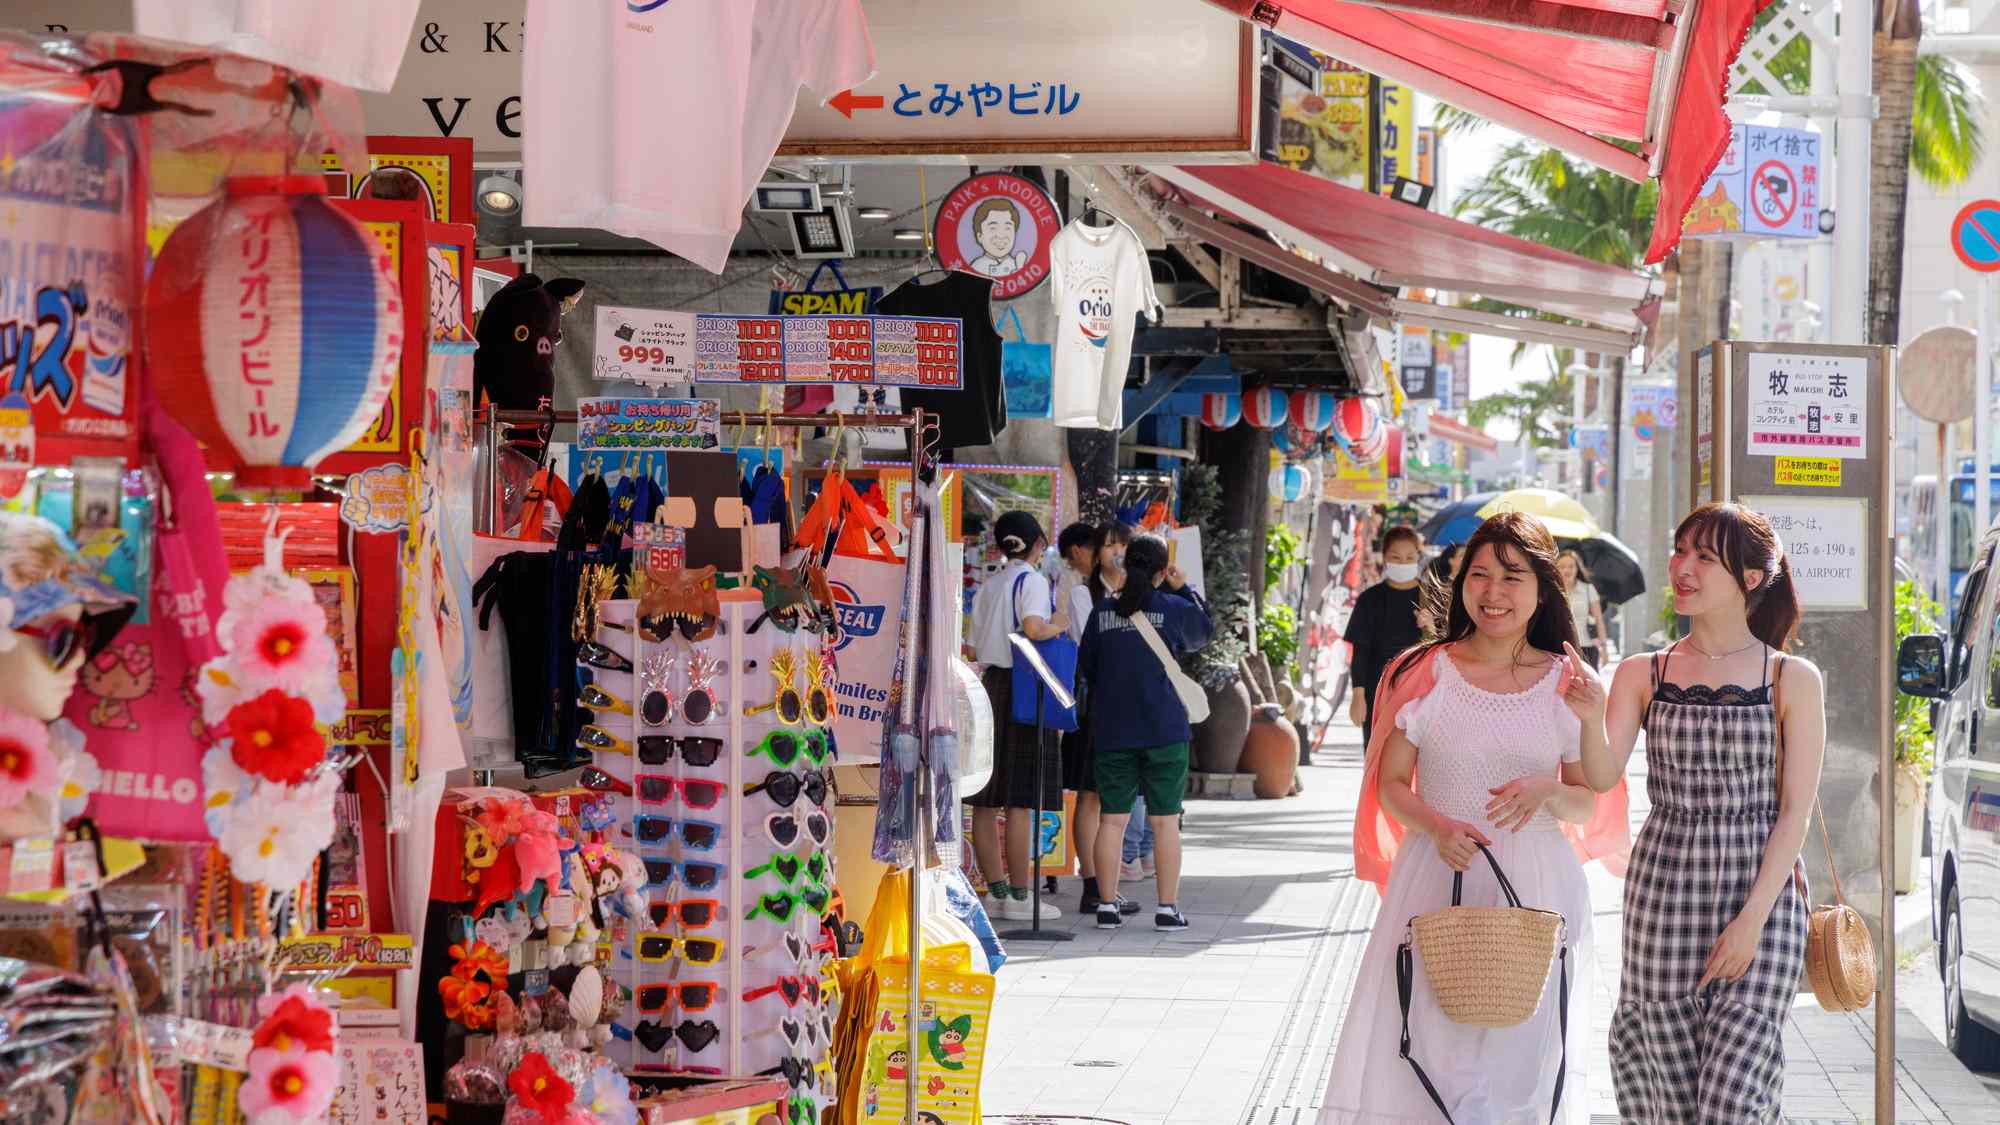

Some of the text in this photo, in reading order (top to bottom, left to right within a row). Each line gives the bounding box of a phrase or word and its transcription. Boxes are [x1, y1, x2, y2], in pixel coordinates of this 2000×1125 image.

[893, 82, 1080, 118] とみやビル
[1752, 132, 1817, 157] ポイ捨て
[998, 178, 1055, 225] NOODLE
[783, 291, 865, 315] SPAM
[236, 212, 281, 439] オリオンビール
[697, 320, 737, 331] ORION
[785, 320, 826, 331] ORION
[697, 341, 737, 352] ORION
[786, 342, 827, 353] ORION
[1769, 369, 1789, 396] 牧
[1793, 386, 1824, 394] MAKISHI
[1828, 373, 1848, 398] 志
[1767, 406, 1785, 414] ホテル
[1806, 568, 1852, 578] AIRPORT
